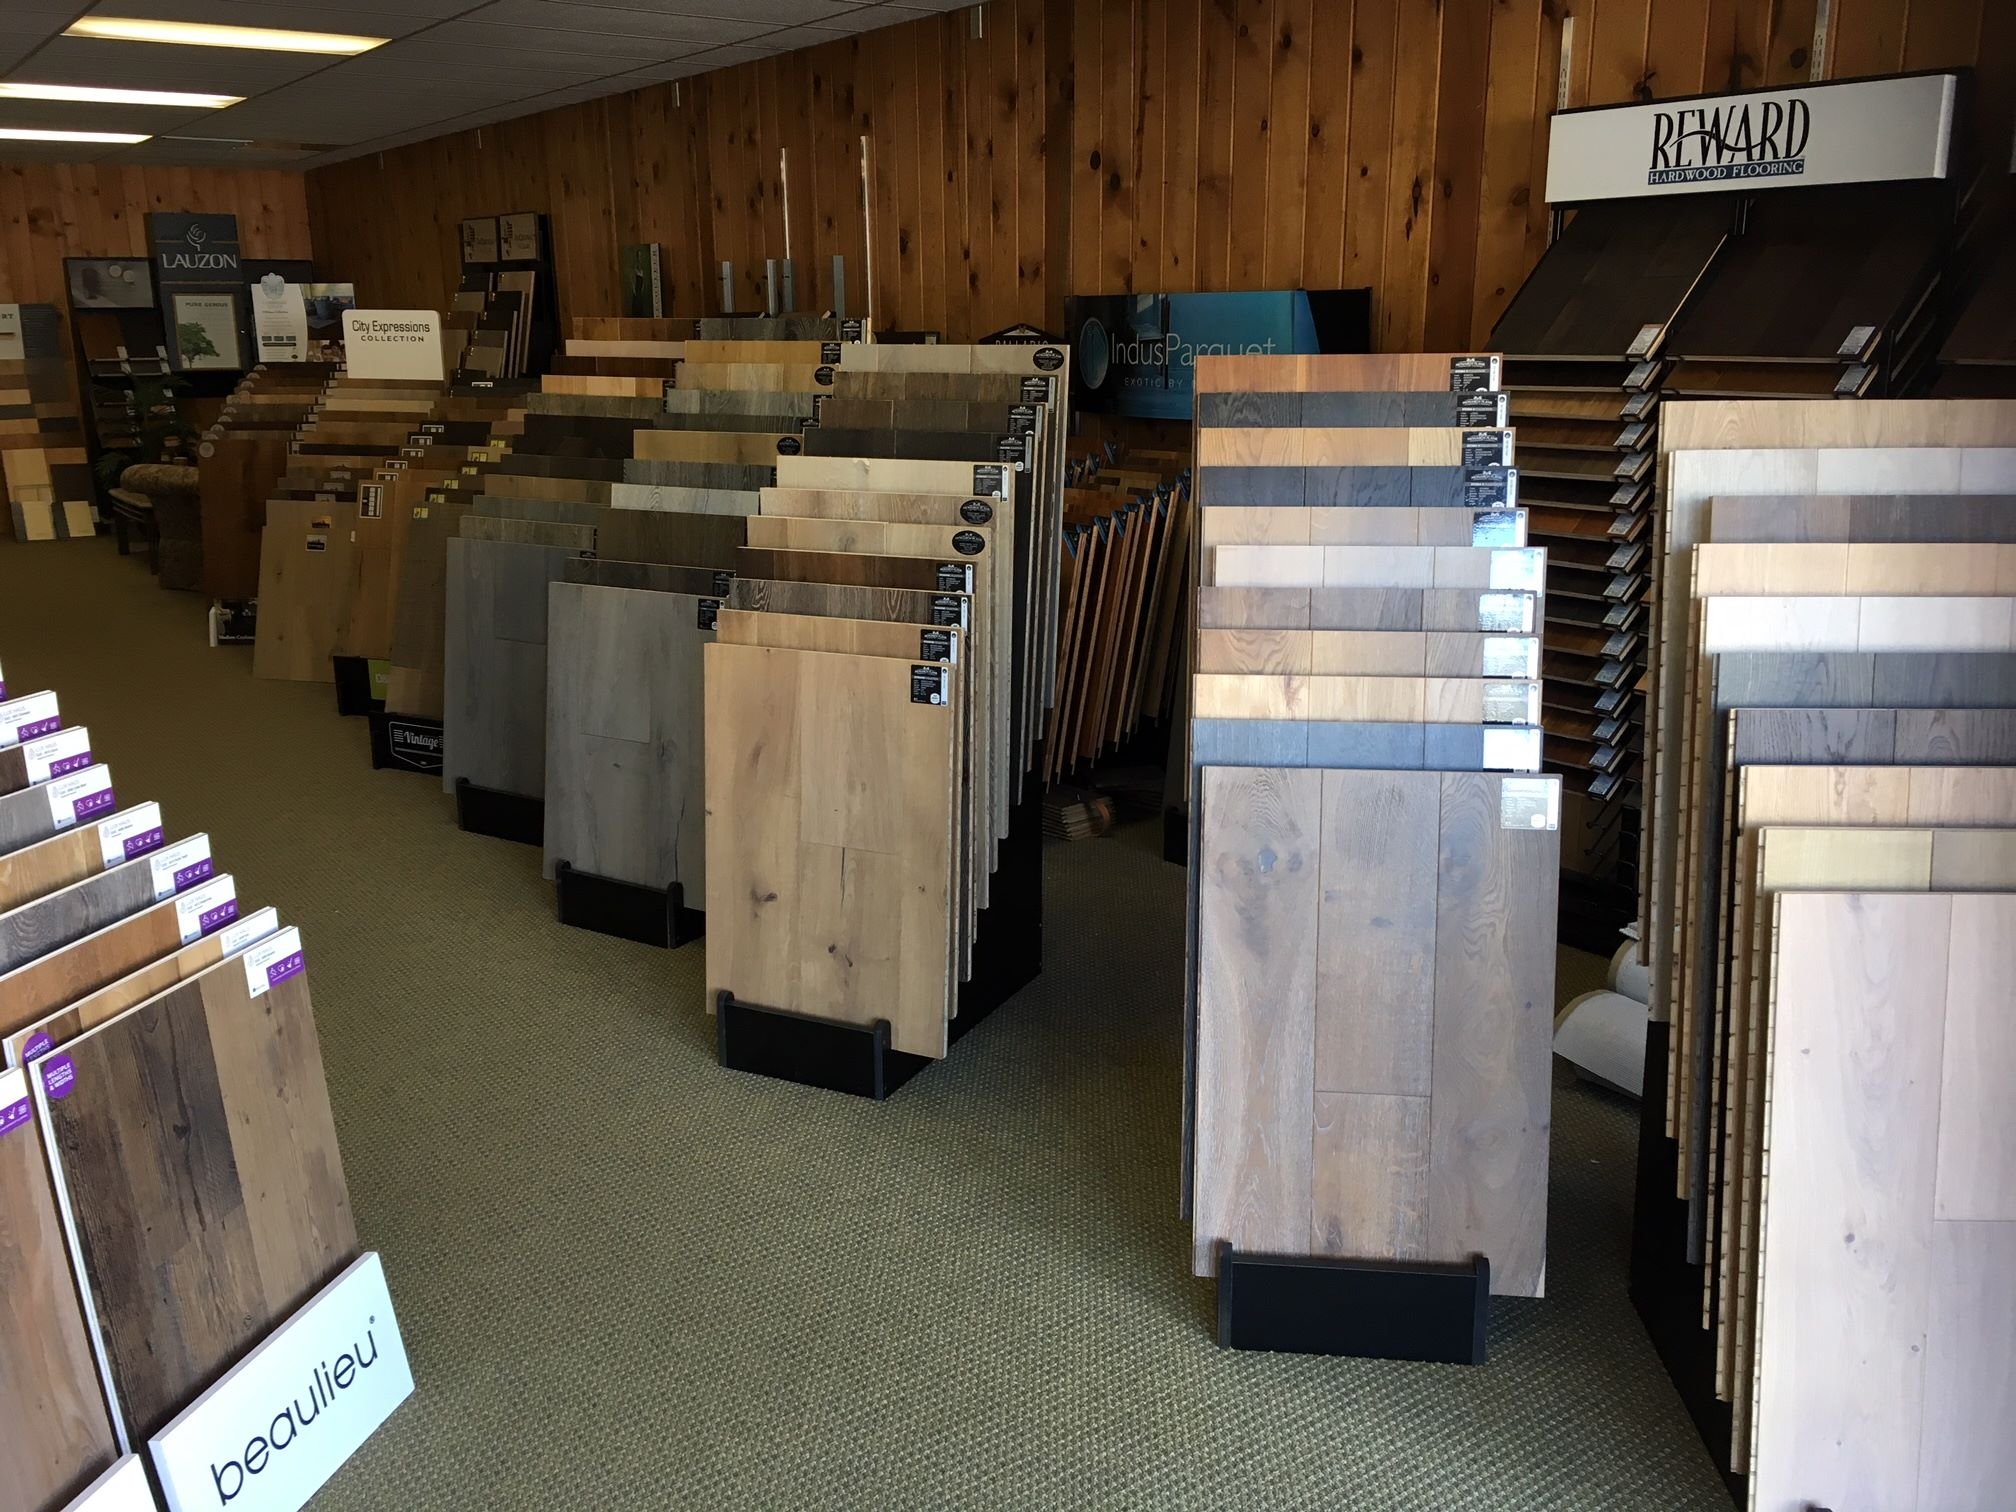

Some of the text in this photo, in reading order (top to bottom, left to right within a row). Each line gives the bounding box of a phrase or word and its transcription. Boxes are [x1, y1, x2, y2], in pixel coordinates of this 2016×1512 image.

[1649, 99, 1810, 170] REWARD
[1650, 160, 1804, 183] HARDWOOD FLOORING
[162, 253, 237, 269] LAUZON
[352, 320, 431, 334] City Expressions
[1124, 377, 1184, 388] EXOTIC BY
[404, 731, 439, 750] Vintage
[46, 1062, 71, 1079] MULTIPLE
[210, 1330, 378, 1506] beaulieu
